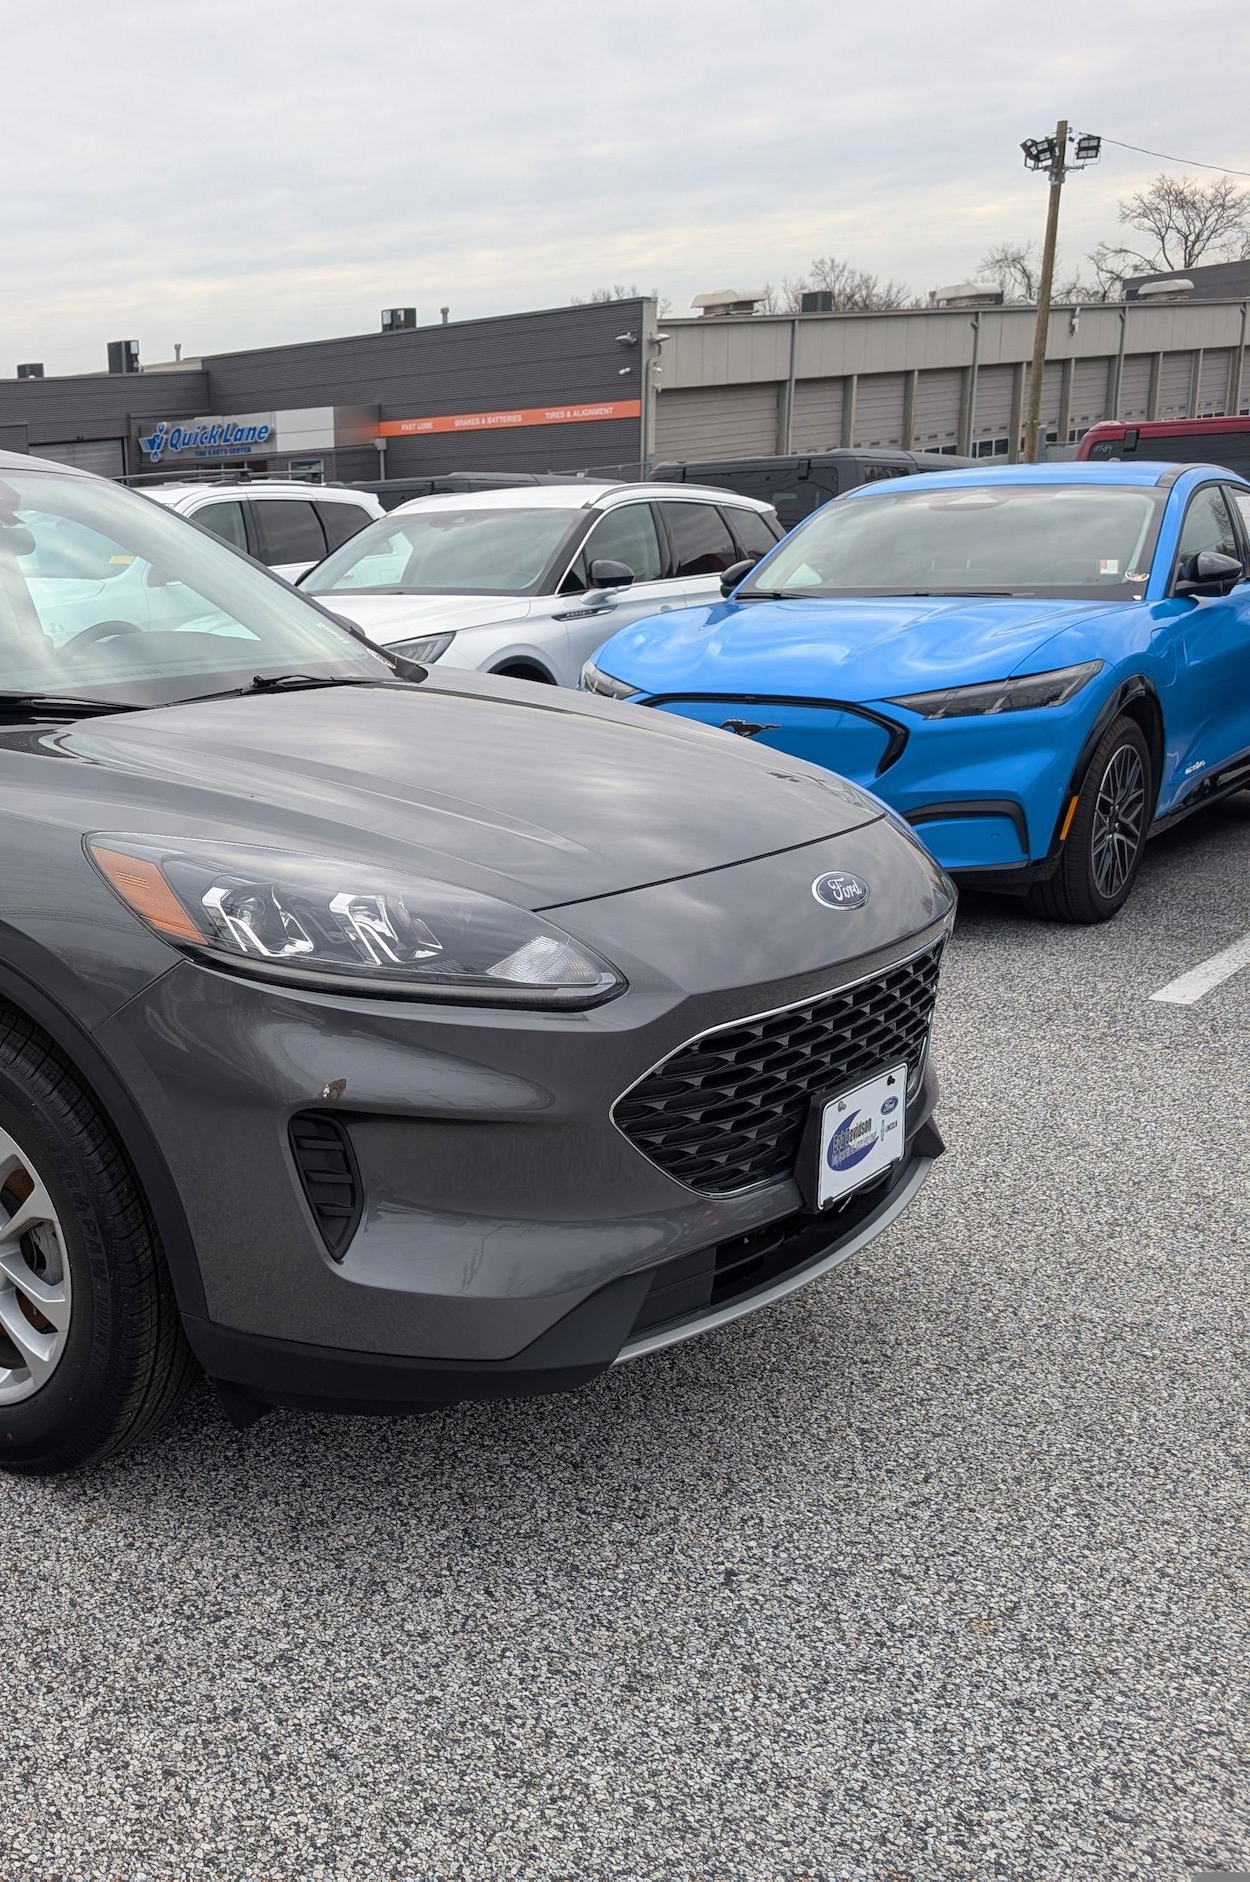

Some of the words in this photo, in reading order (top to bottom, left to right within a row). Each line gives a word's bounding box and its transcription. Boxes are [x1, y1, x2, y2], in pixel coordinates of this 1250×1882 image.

[545, 411, 565, 419] TIRES
[573, 406, 615, 417] ALIGNMENT
[401, 422, 416, 431] FAST
[417, 421, 433, 430] LUBE
[454, 418, 480, 427] BRAKES
[486, 414, 522, 424] BATTERIES
[168, 425, 220, 452] Quick
[221, 422, 270, 445] Lane
[827, 877, 863, 902] Ford
